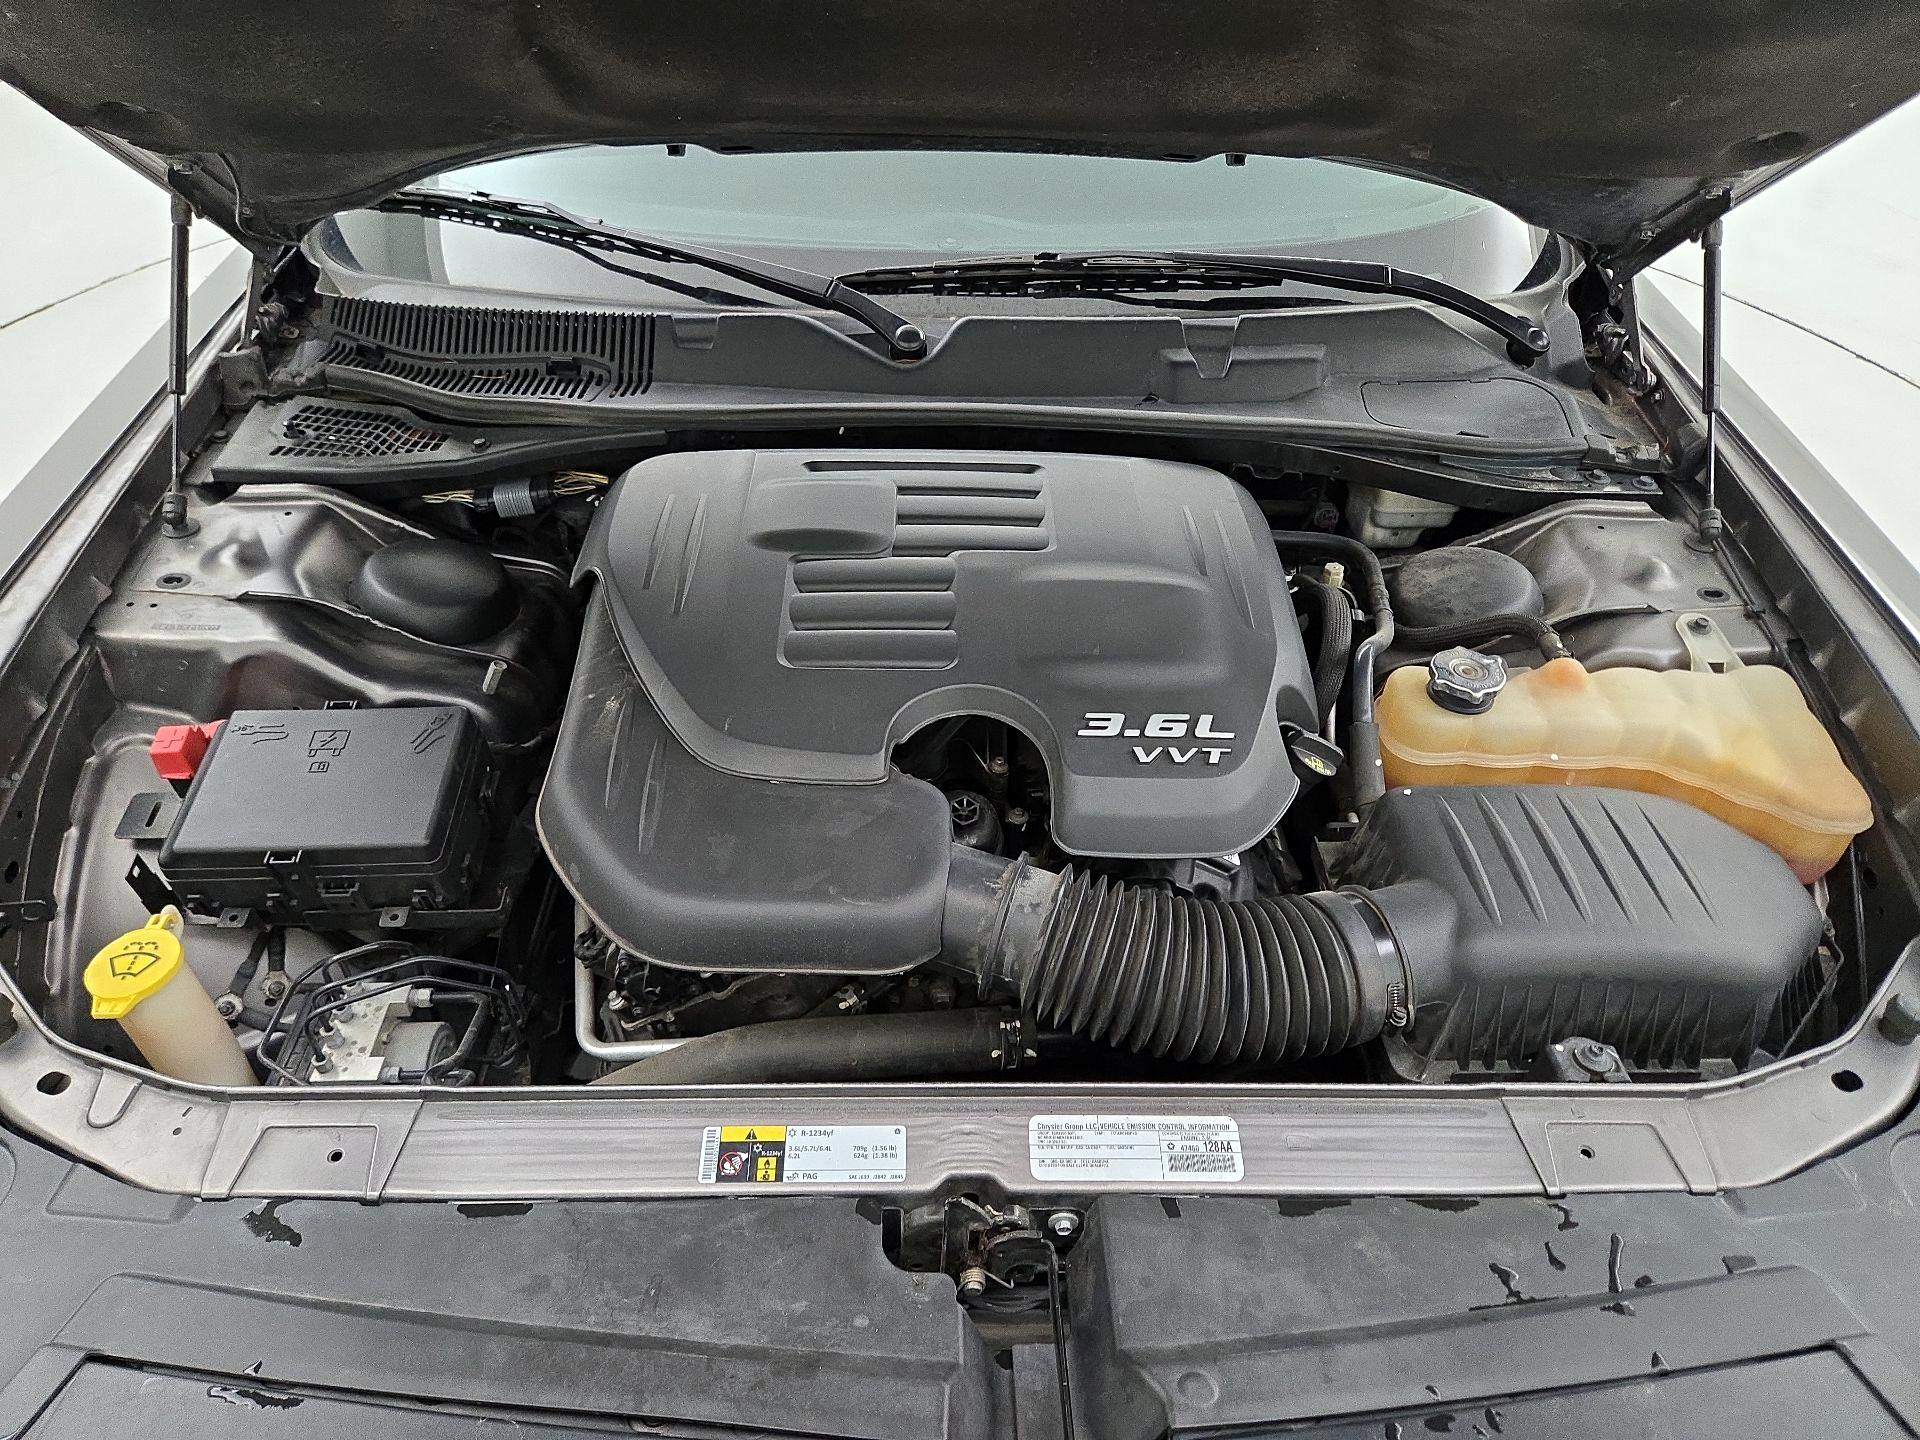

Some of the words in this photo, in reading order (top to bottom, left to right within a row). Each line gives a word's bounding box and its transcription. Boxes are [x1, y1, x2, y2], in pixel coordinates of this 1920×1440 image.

[1077, 712, 1235, 739] 3.6L
[1132, 746, 1232, 764] VVT
[1037, 1122, 1062, 1130] Chrysler
[1064, 1122, 1083, 1130] Group
[1099, 1122, 1125, 1130] VEHICLE
[1127, 1122, 1156, 1130] EMISSION
[1158, 1122, 1185, 1130] CONTROL
[1187, 1123, 1230, 1131] INFORMATION
[801, 1129, 834, 1138] R-1234yf
[788, 1144, 832, 1152] 3.6L/5.7L/6.4L
[852, 1145, 868, 1153] 709g
[1203, 1140, 1233, 1152] 128AA
[853, 1152, 868, 1160] 624g
[889, 1152, 898, 1160] lb)
[802, 1172, 818, 1180] PAG
